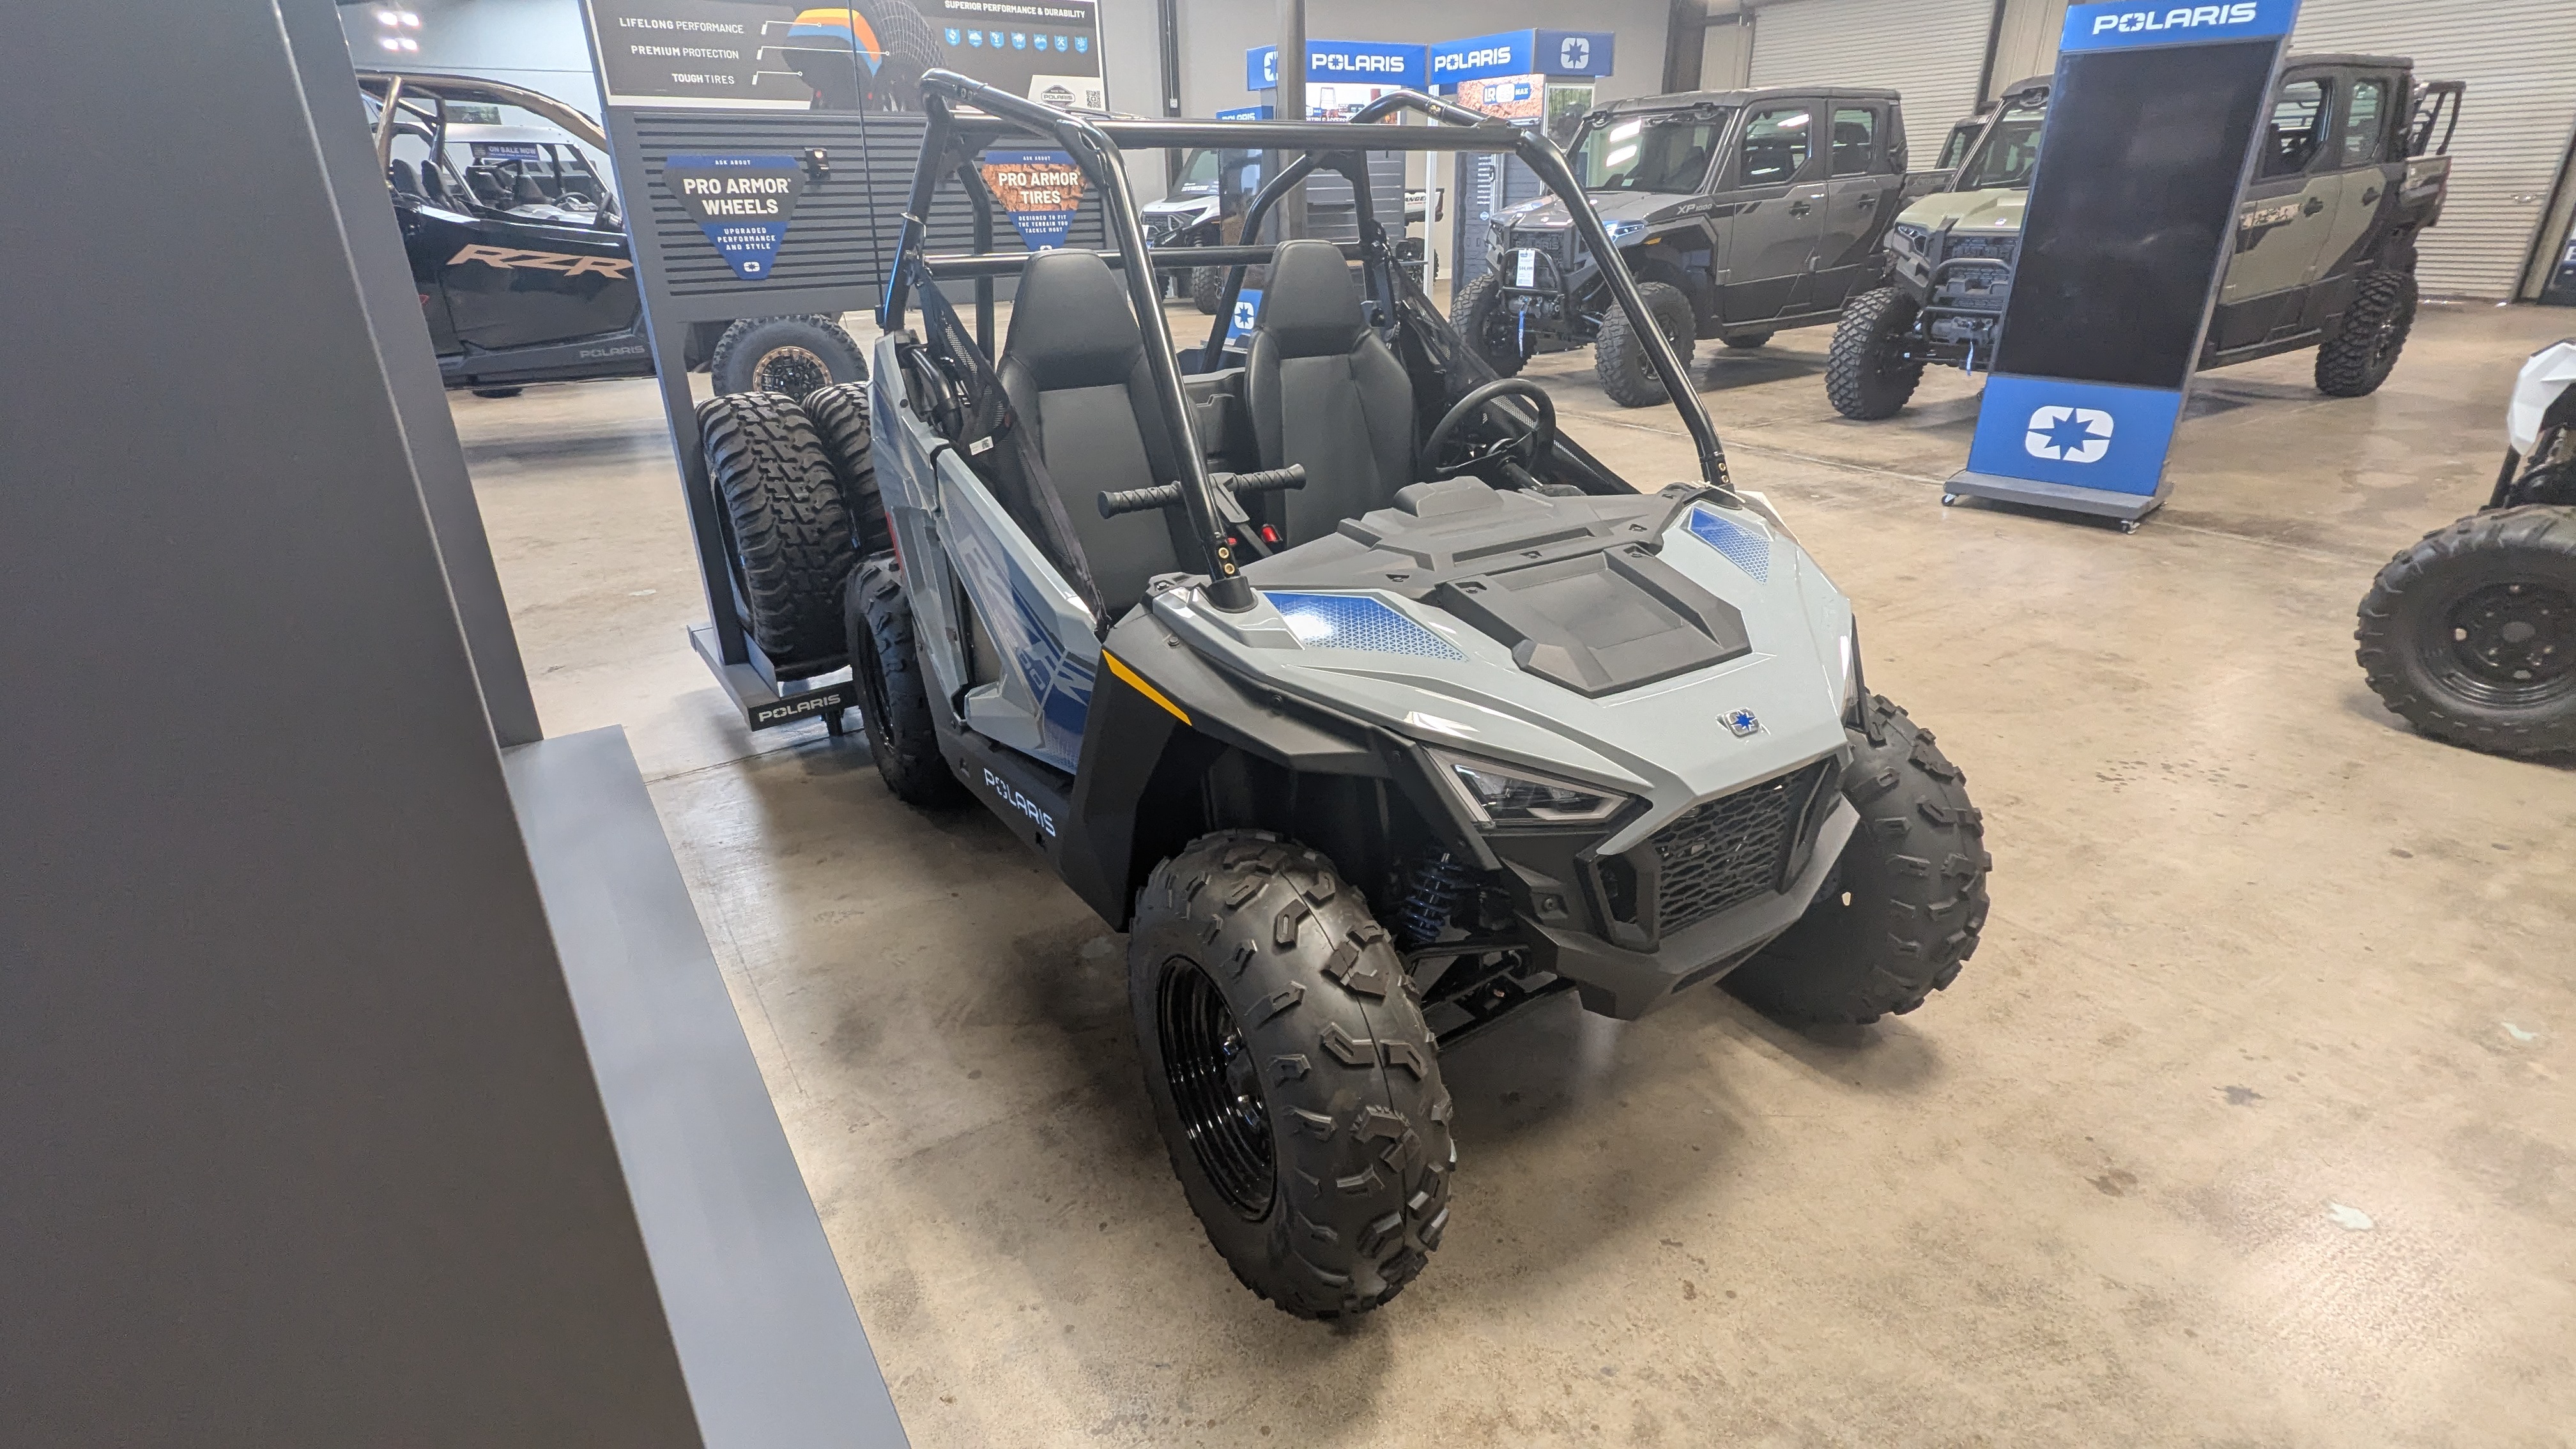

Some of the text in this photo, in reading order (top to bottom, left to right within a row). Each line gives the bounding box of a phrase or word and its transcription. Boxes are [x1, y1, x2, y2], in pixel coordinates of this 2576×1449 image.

[944, 0, 982, 11] SUPERIOR
[983, 3, 1036, 15] PERFORMANCE
[1044, 8, 1085, 19] DURABILITY
[619, 17, 744, 34] LIFELONG PERFORMANCE
[2092, 2, 2257, 35] POLARIS
[631, 45, 740, 59] PREMIUM PROTECTION
[1434, 46, 1511, 72] POLARIS
[1312, 53, 1405, 72] POLARIS
[671, 73, 735, 84] TOUGH TIRES
[683, 178, 790, 194] PRO ARMOR
[999, 172, 1078, 186] PRO ARMOR
[1020, 190, 1061, 204] TIRES
[702, 199, 779, 215] WHEELS
[1676, 204, 1696, 215] XP
[717, 234, 776, 243] PERFORMANCE
[447, 244, 634, 279] RZR
[579, 346, 645, 358] POLARIS
[758, 693, 841, 723] POLARIS
[984, 768, 1056, 838] POLARIS
